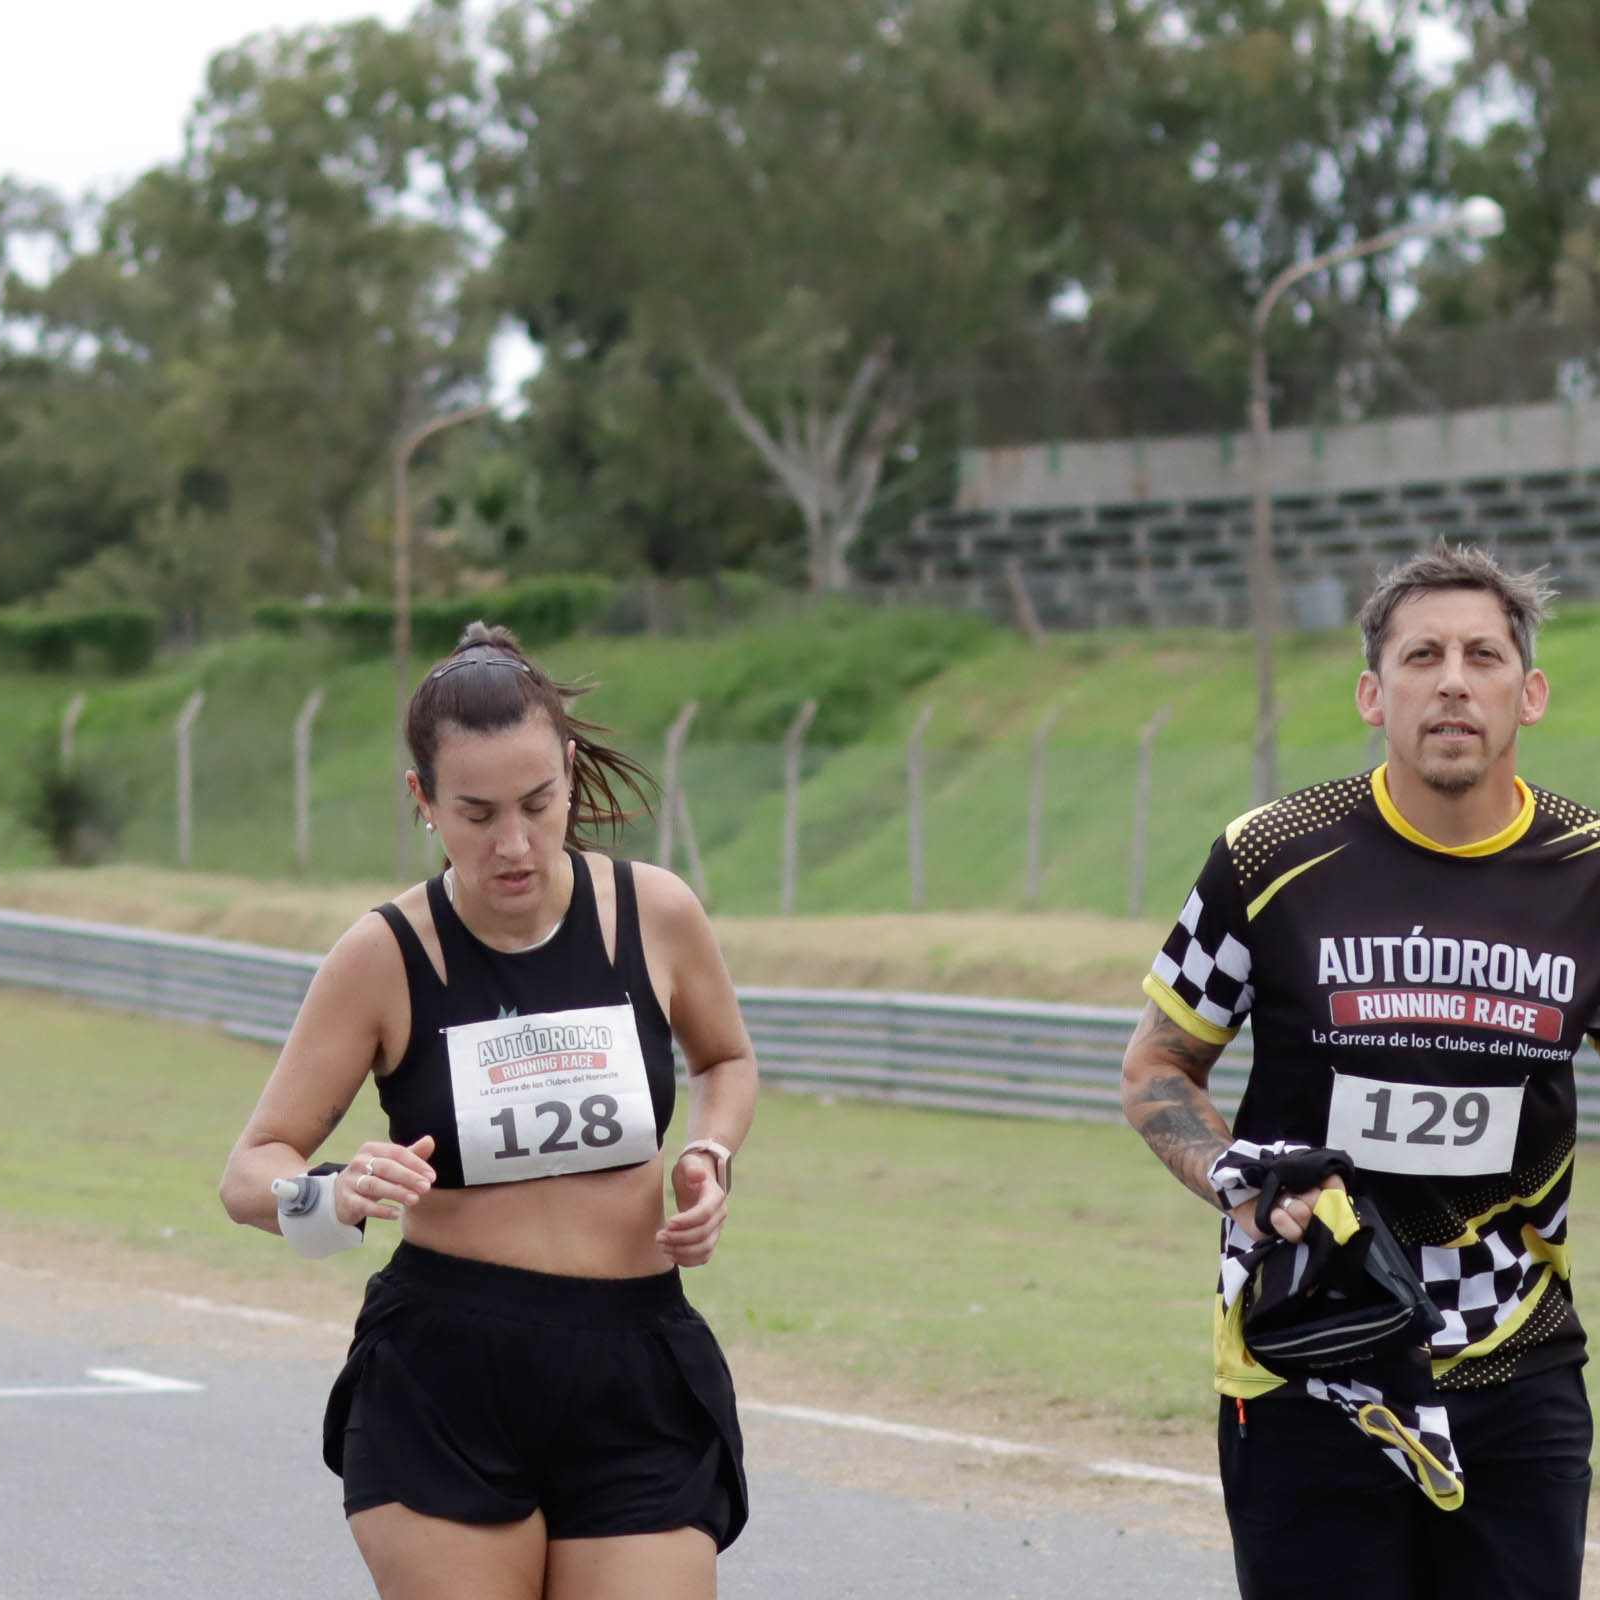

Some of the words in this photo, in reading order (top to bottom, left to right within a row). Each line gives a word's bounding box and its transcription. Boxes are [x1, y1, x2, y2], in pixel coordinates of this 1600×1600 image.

[1315, 925, 1576, 1003] AUTÓDROMO
[1357, 992, 1467, 1021] RUNNING
[1473, 997, 1538, 1033] RACE
[477, 1024, 613, 1067] AUTÓDROMO
[1312, 1029, 1326, 1044] La
[1329, 1030, 1385, 1046] Carrera
[1390, 1032, 1408, 1047] de
[1411, 1033, 1432, 1048] los
[1435, 1035, 1486, 1053] Clubes
[1489, 1040, 1513, 1056] del
[490, 1083, 519, 1095] Carrera
[520, 1080, 530, 1091] de
[532, 1079, 544, 1089] los
[545, 1076, 571, 1088] Clubes
[572, 1073, 585, 1084] del
[501, 1055, 557, 1080] RUNNING
[560, 1054, 594, 1069] RACE
[490, 1094, 623, 1159] 128
[1361, 1088, 1491, 1146] 129
